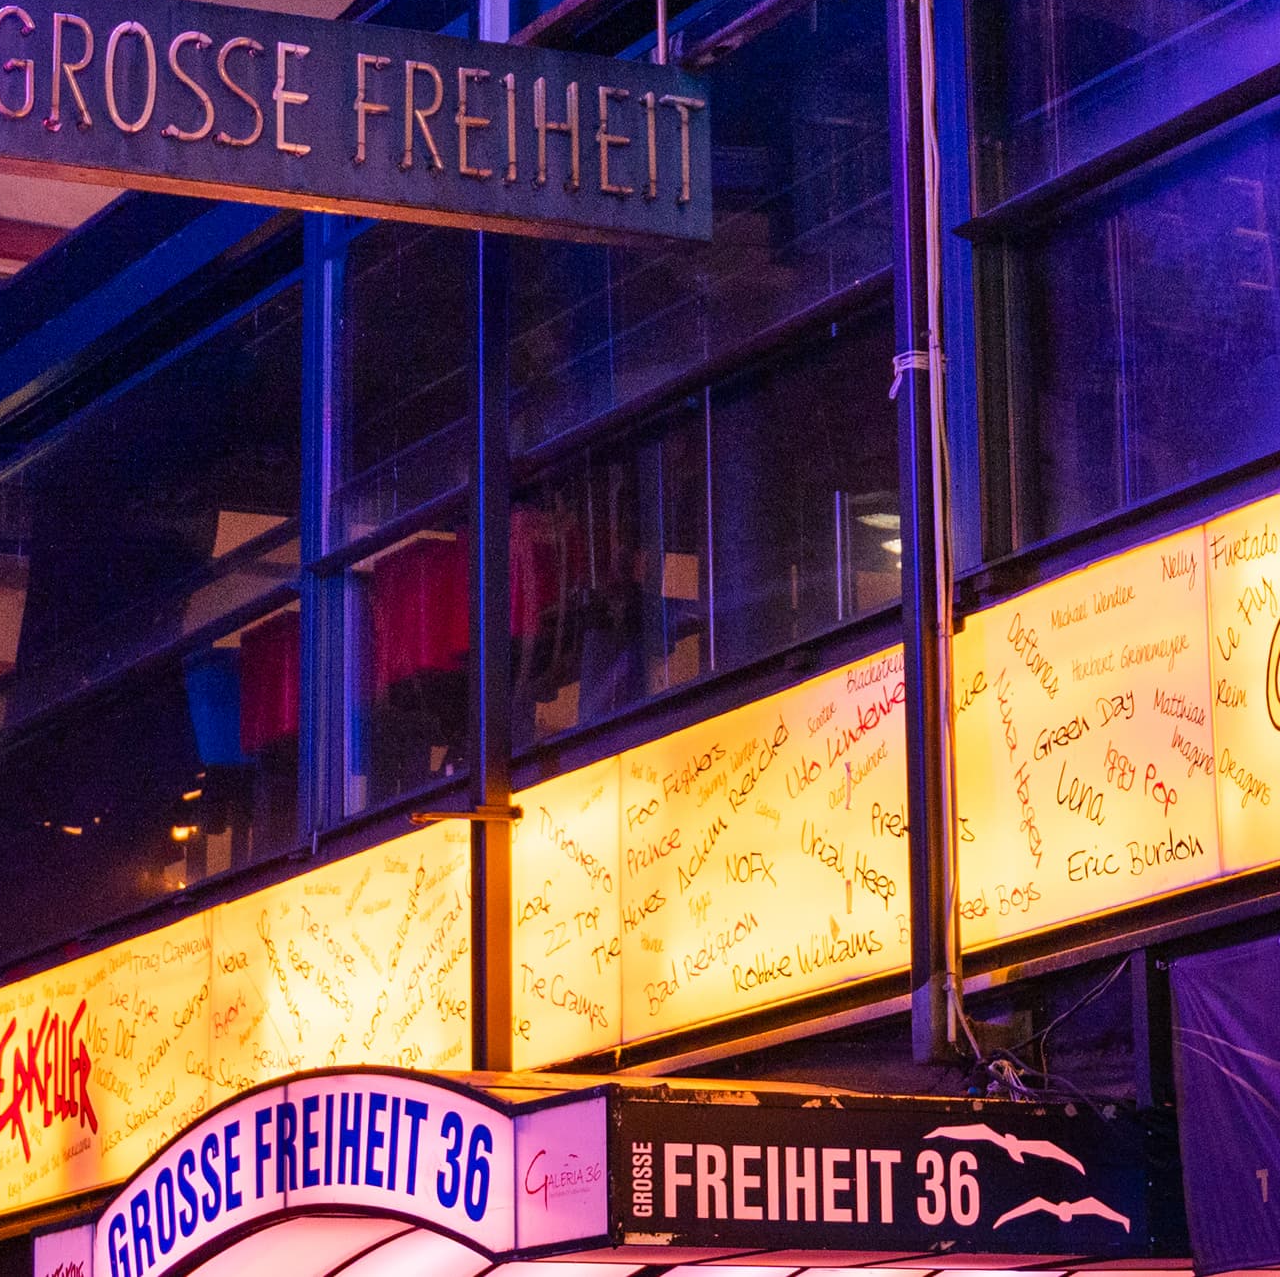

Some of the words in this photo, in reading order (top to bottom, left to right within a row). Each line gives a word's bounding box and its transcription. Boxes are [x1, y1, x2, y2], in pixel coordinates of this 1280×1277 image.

[354, 53, 706, 205] FREIHEIT
[1160, 549, 1197, 591] Nelly
[1033, 716, 1091, 762] Green
[1096, 689, 1135, 728] Day
[785, 756, 822, 799] Udo
[1056, 760, 1106, 826] Lena
[626, 799, 660, 833] Foo
[627, 828, 681, 879] Prince
[724, 851, 777, 888] NOFX
[853, 850, 897, 912] Heep
[1068, 846, 1120, 882] Eric
[1126, 828, 1205, 876] Burdon
[622, 889, 666, 934] Hives
[644, 960, 680, 1016] Bad
[733, 952, 792, 993] Robbie
[796, 929, 883, 977] Williams
[108, 1121, 241, 1277] GROSSE
[254, 1093, 427, 1199] FREIHEIT
[436, 1111, 493, 1223] 36
[632, 1142, 653, 1218] GROSSE
[663, 1142, 901, 1223] FREIHEIT
[916, 1150, 980, 1227] 36
